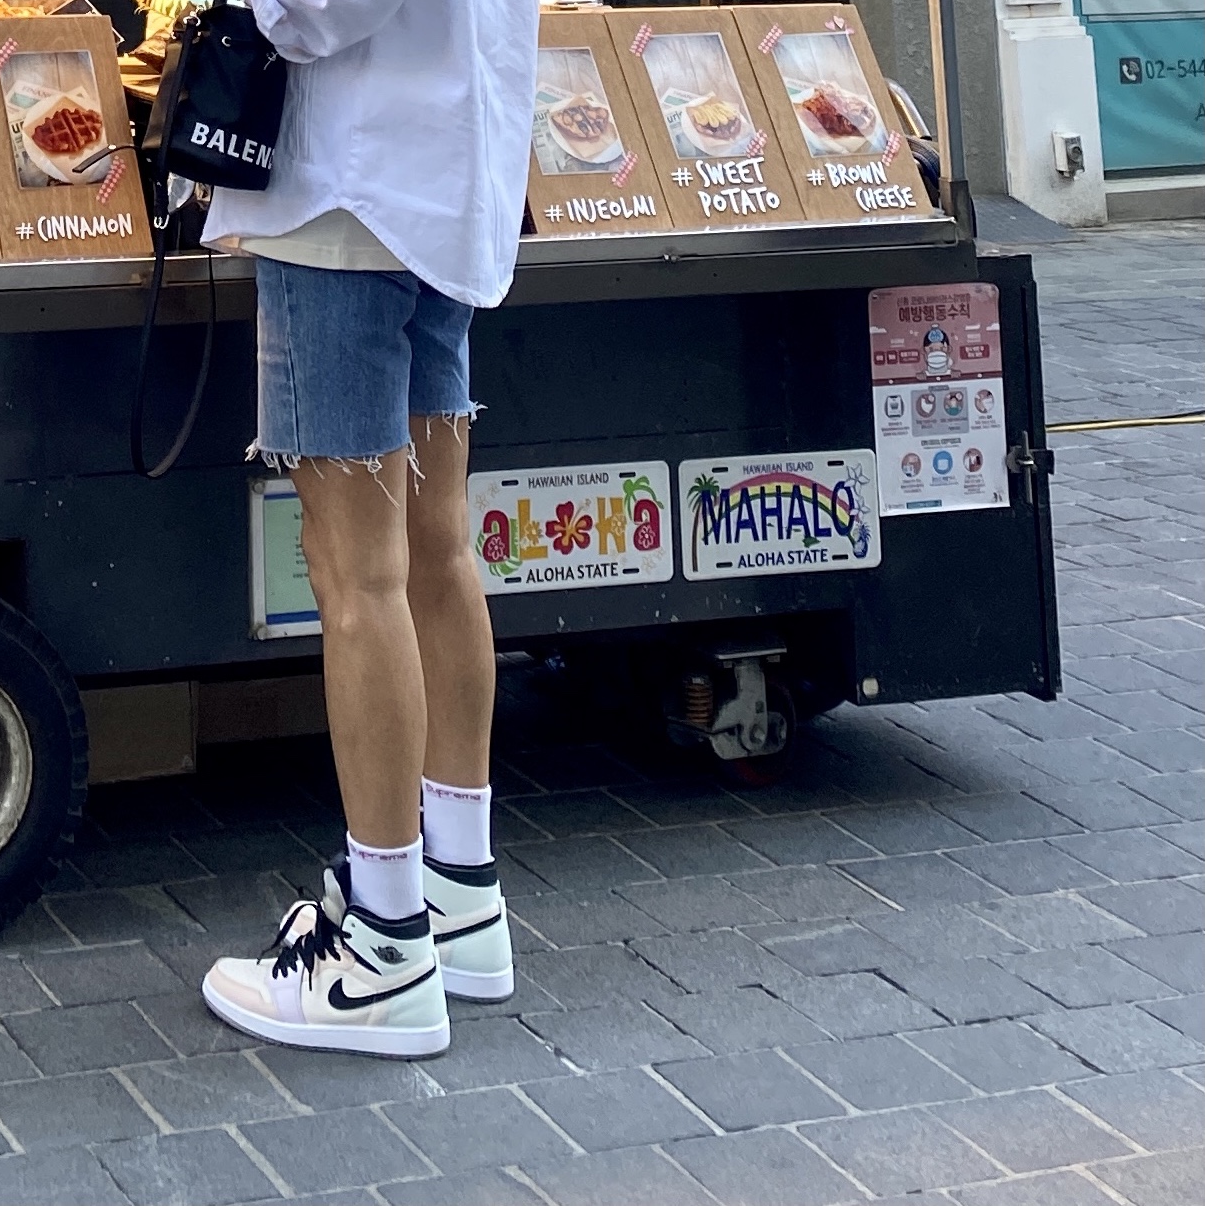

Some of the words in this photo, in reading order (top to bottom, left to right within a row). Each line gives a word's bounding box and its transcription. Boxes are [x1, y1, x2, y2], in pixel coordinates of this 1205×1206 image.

[698, 185, 780, 217] POTATO
[856, 185, 917, 210] CHEESE
[742, 463, 783, 475] HAWAIIAN
[785, 461, 815, 472] ISLAND
[528, 476, 573, 490] HAWAIIAN
[576, 472, 610, 486] ISLAND
[700, 480, 856, 546] MAHALO
[737, 552, 785, 569] ALOHA
[787, 548, 829, 565] STATE
[525, 567, 575, 584] ALOHA
[577, 562, 619, 580] STATE
